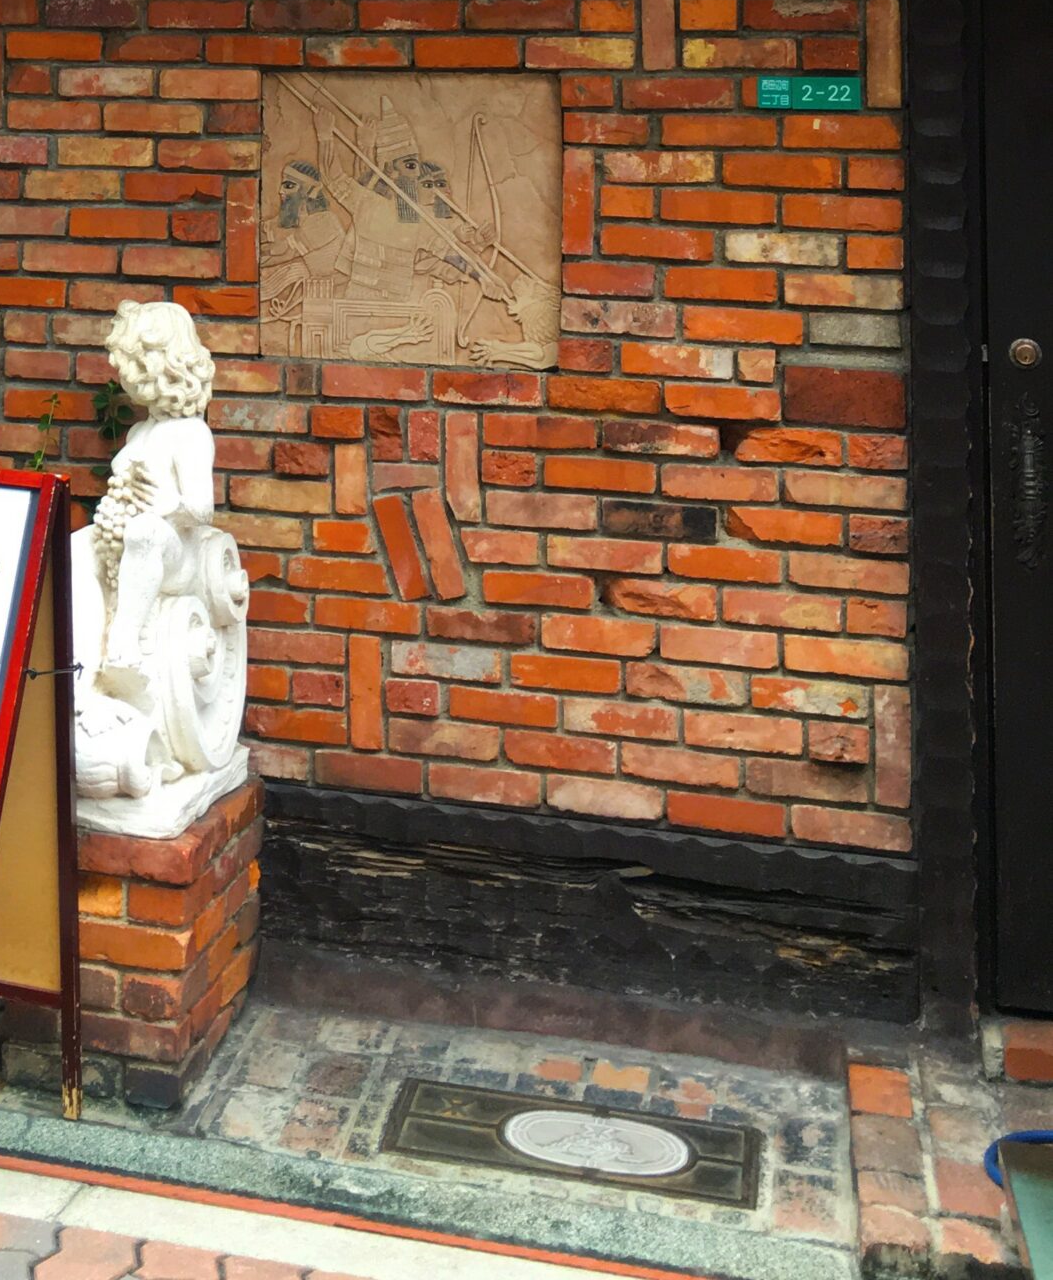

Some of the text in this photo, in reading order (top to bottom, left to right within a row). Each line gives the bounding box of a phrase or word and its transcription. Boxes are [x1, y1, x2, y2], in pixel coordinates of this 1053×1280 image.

[761, 94, 790, 106] 二丁目
[802, 84, 852, 102] 2-22
